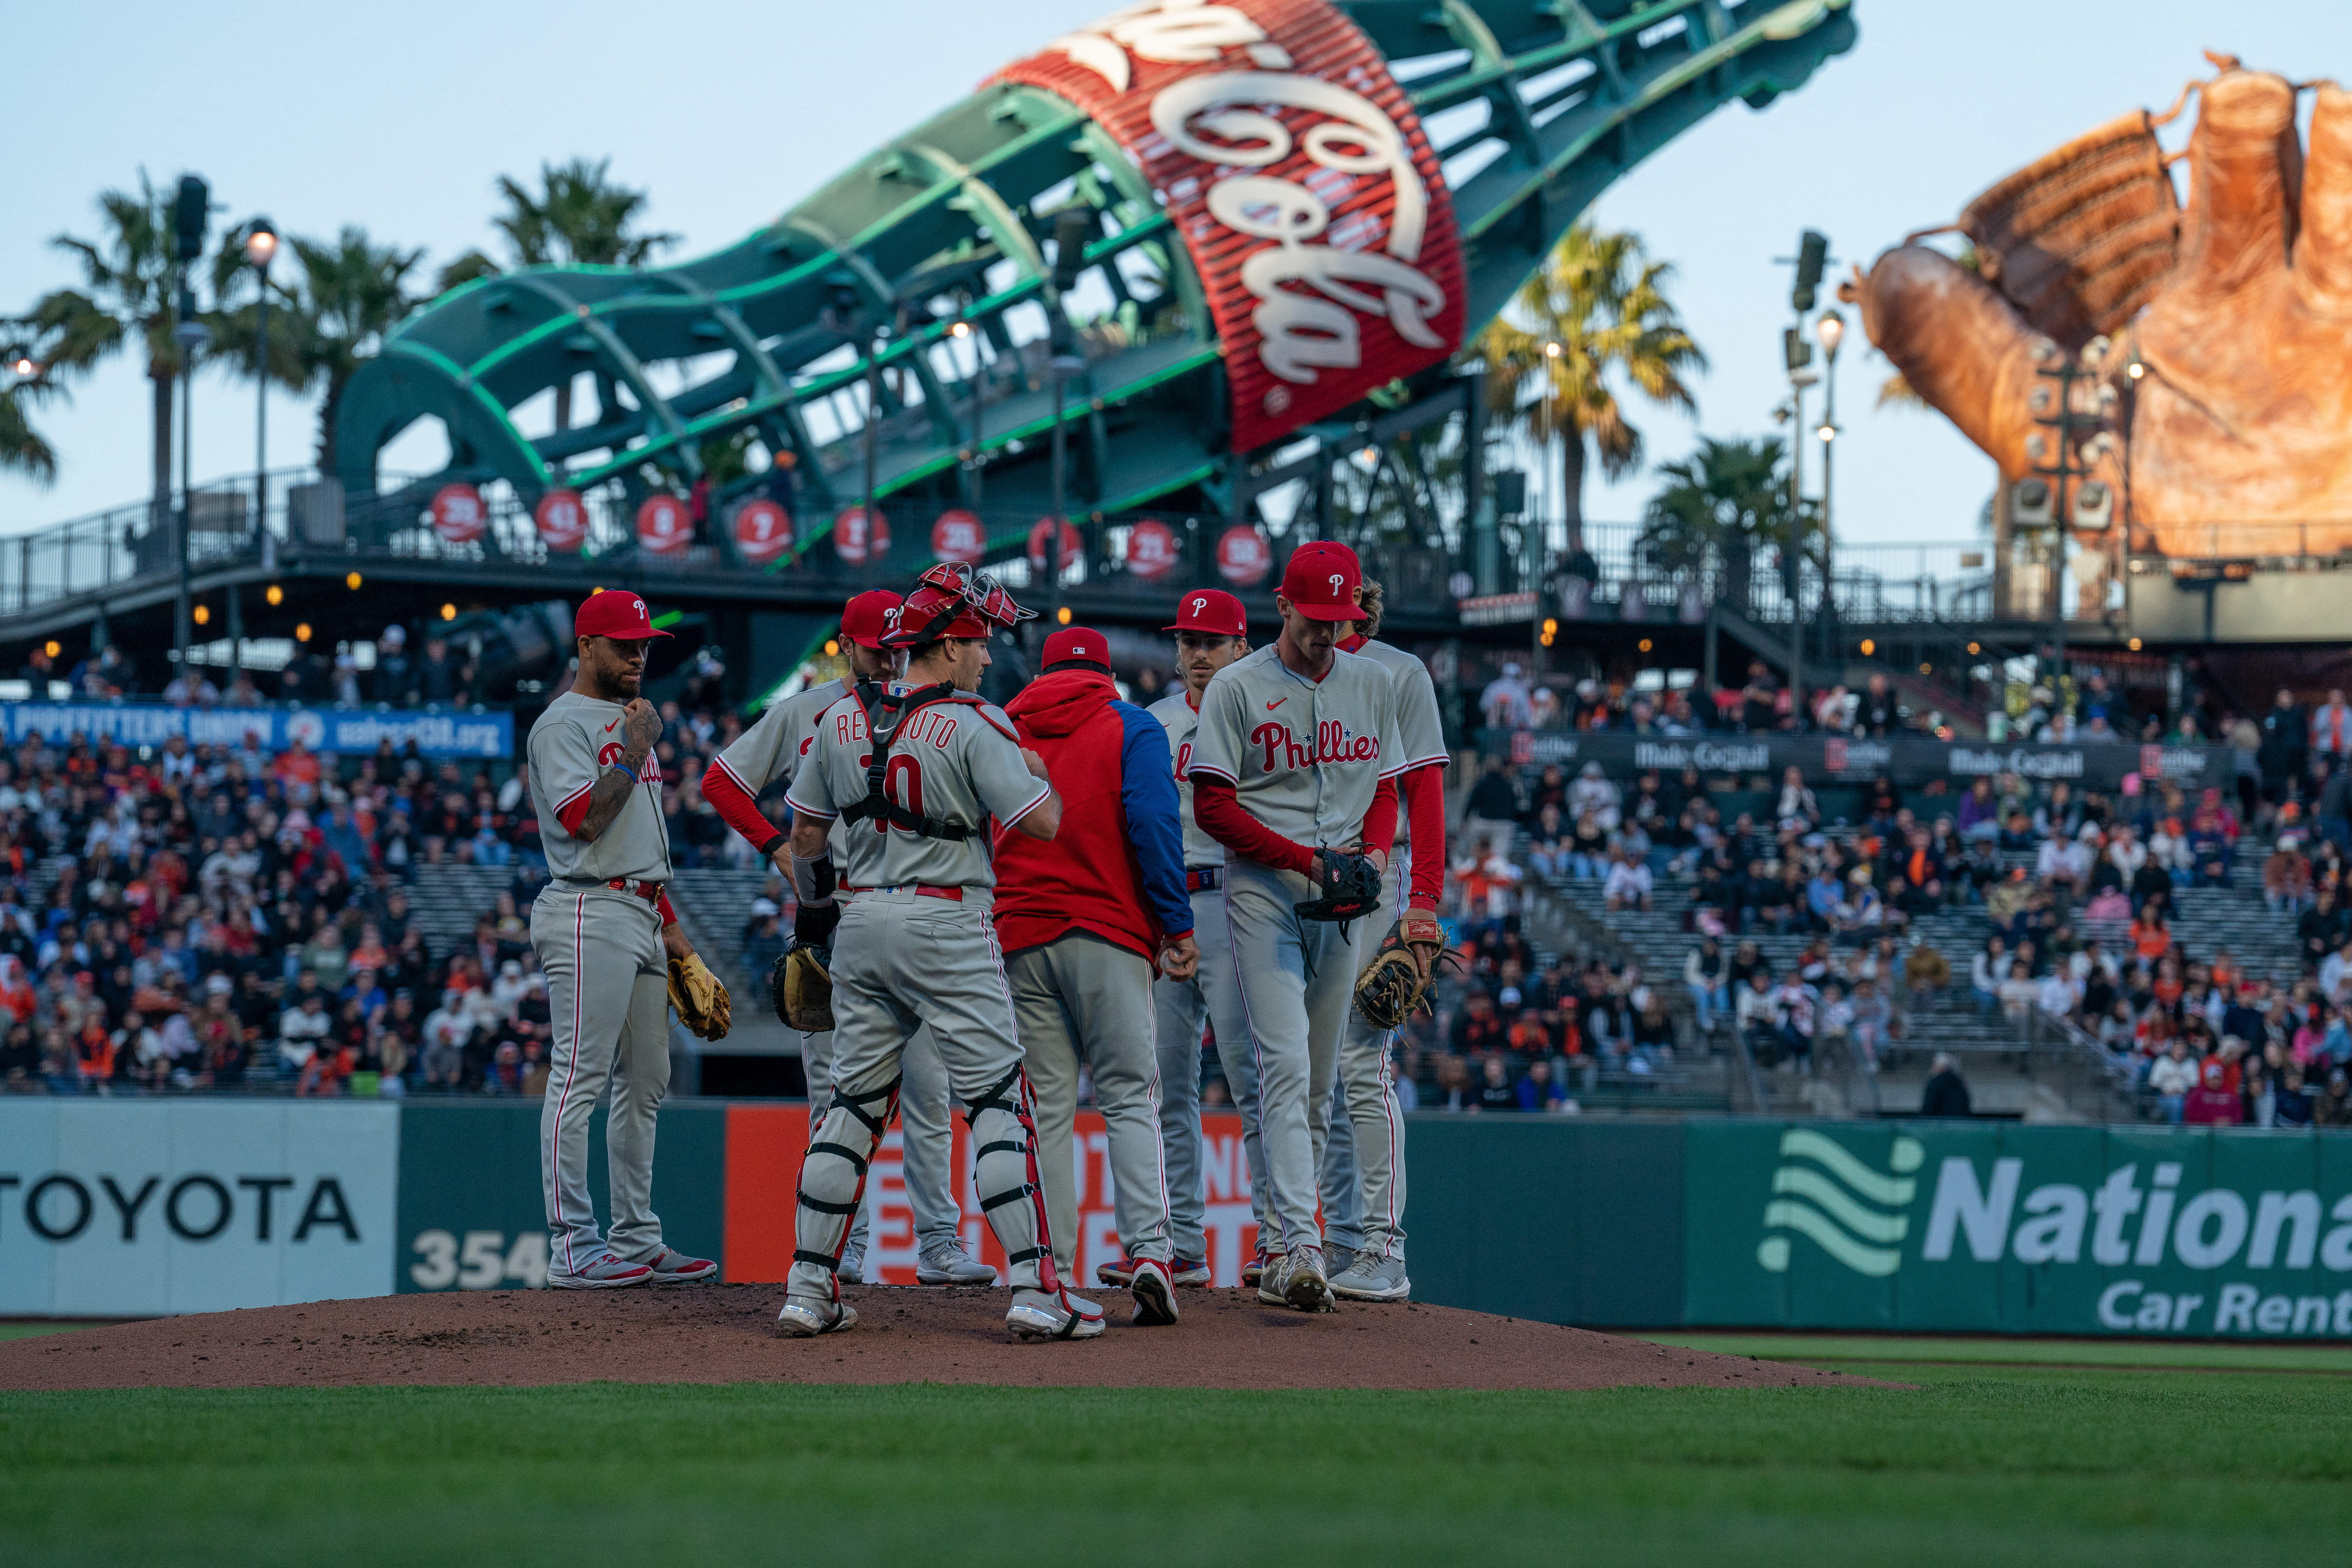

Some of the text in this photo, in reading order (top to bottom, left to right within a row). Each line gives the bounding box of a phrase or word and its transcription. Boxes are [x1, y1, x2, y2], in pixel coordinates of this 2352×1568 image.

[1329, 574, 1343, 596] P
[633, 600, 645, 620] P
[1192, 598, 1207, 617] P
[1250, 719, 1380, 774] Phillies
[2097, 1280, 2202, 1330] Car
